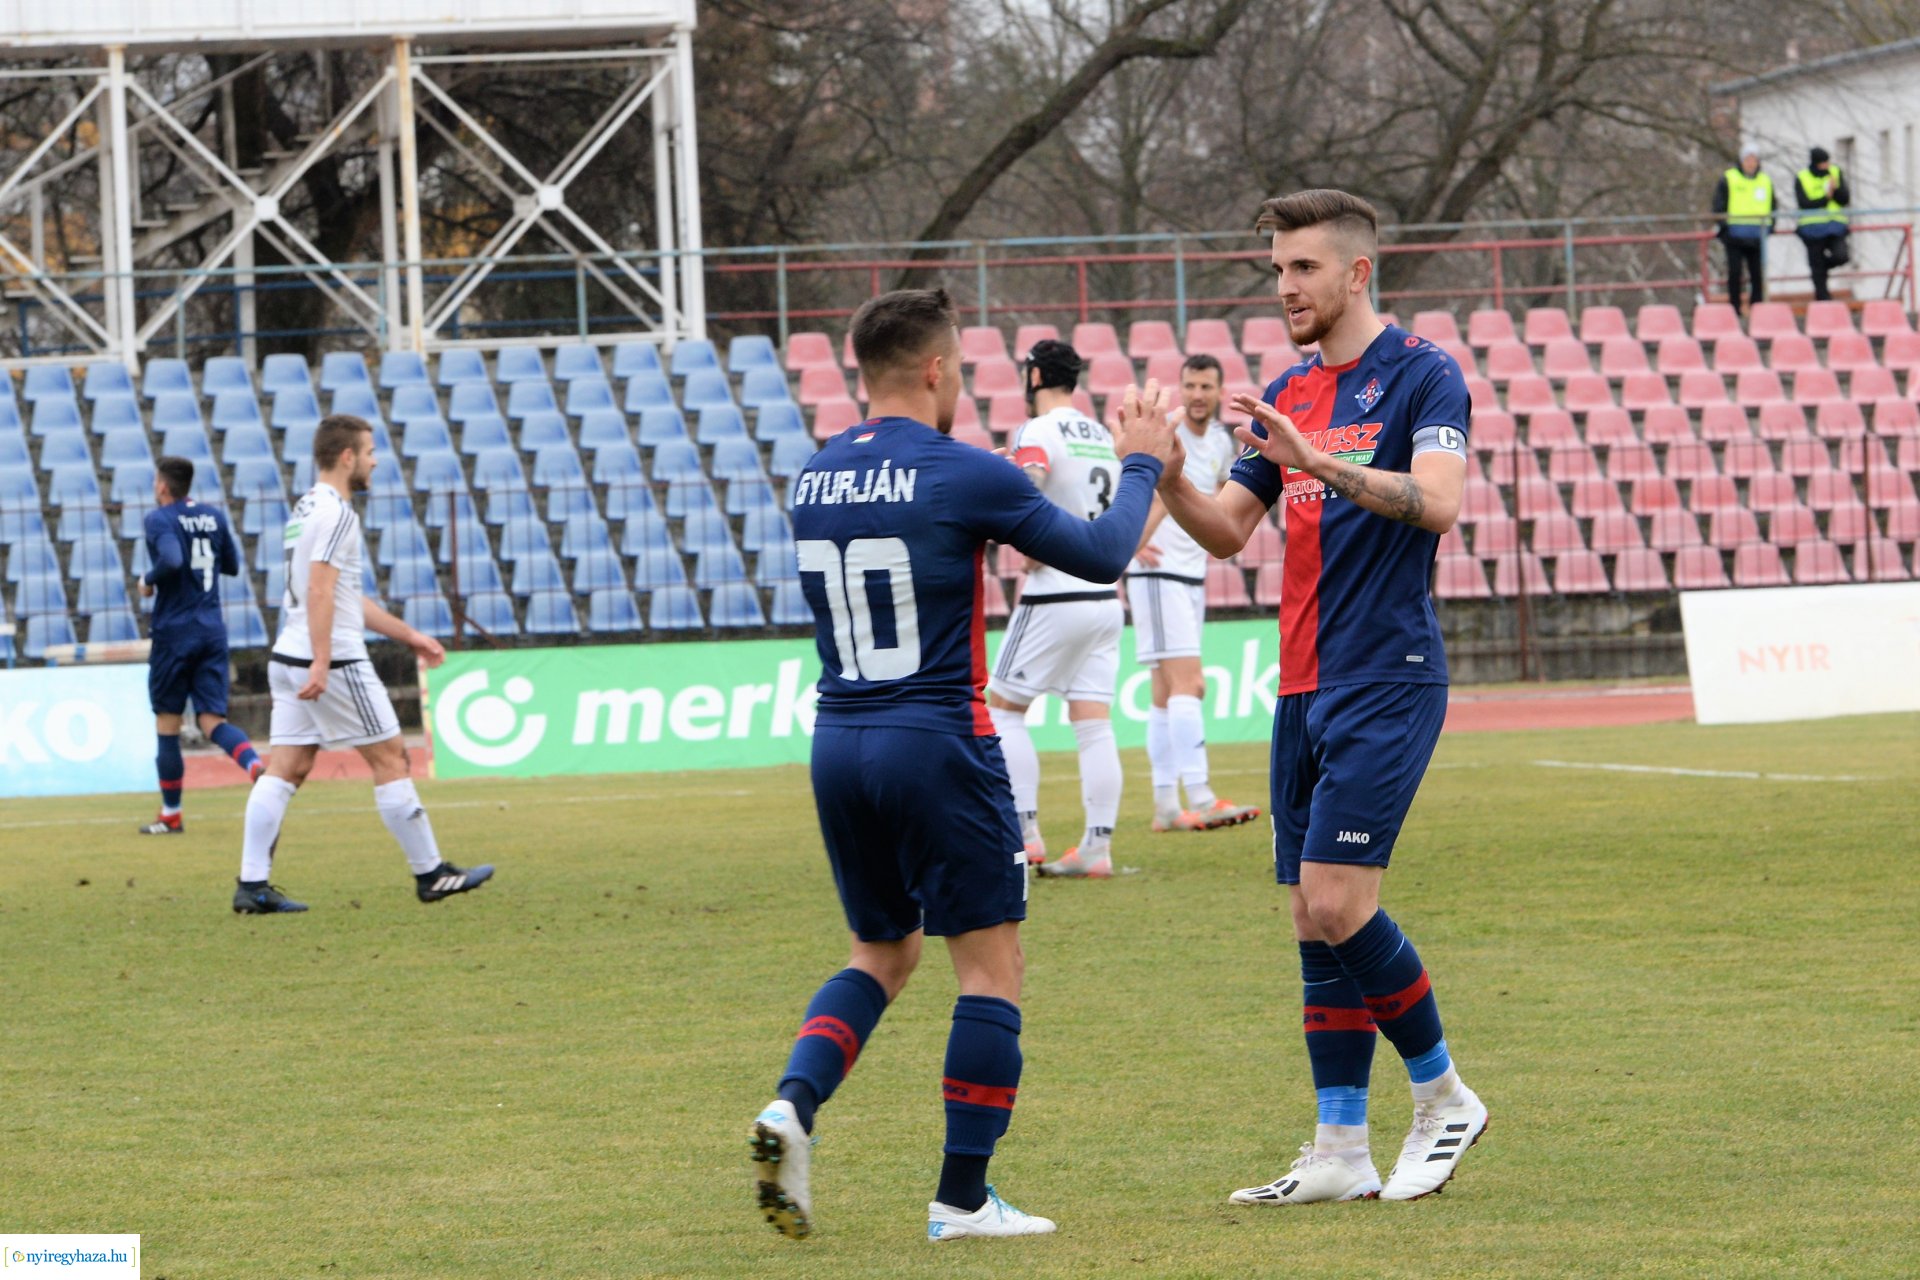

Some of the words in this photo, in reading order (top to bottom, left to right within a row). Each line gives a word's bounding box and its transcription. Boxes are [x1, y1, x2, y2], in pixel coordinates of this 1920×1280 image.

[1438, 426, 1458, 449] C
[795, 459, 917, 505] GYURJÁN
[1089, 466, 1112, 521] 3
[190, 537, 215, 593] 4
[1738, 643, 1831, 674] NYIR
[1336, 830, 1370, 844] JAKO
